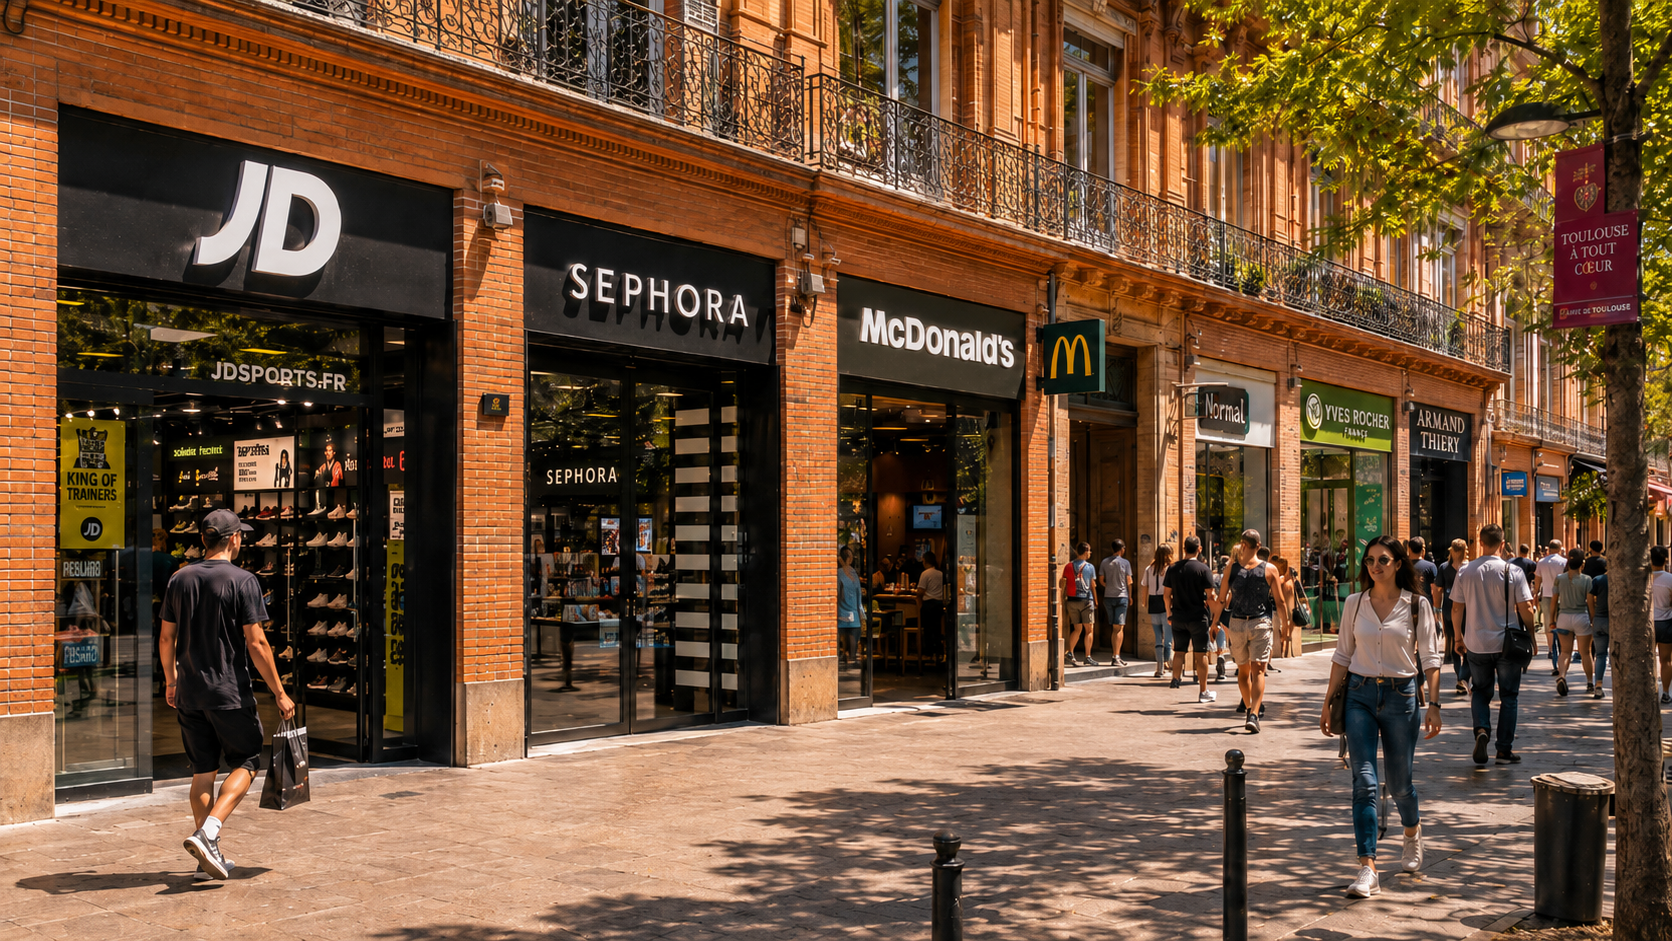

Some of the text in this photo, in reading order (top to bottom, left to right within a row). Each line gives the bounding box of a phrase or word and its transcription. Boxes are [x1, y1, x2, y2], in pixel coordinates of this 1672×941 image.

[192, 160, 342, 277] JD
[1561, 224, 1629, 246] TOULOUSE
[1569, 242, 1617, 260] À TOUT
[569, 263, 749, 328] SEPHORA
[1592, 303, 1631, 314] TOULOUSE
[859, 307, 1015, 368] McDonald's
[211, 361, 347, 391] JDSPORTS.FR
[1205, 392, 1246, 424] Normal
[1325, 404, 1390, 430] YVES ROCHER
[1417, 408, 1465, 434] ARMAND
[1420, 431, 1460, 454] THIERY
[67, 472, 117, 487] KING OF
[546, 466, 617, 485] SEPHORA
[67, 488, 117, 501] TRAINERS
[83, 522, 101, 536] JD
